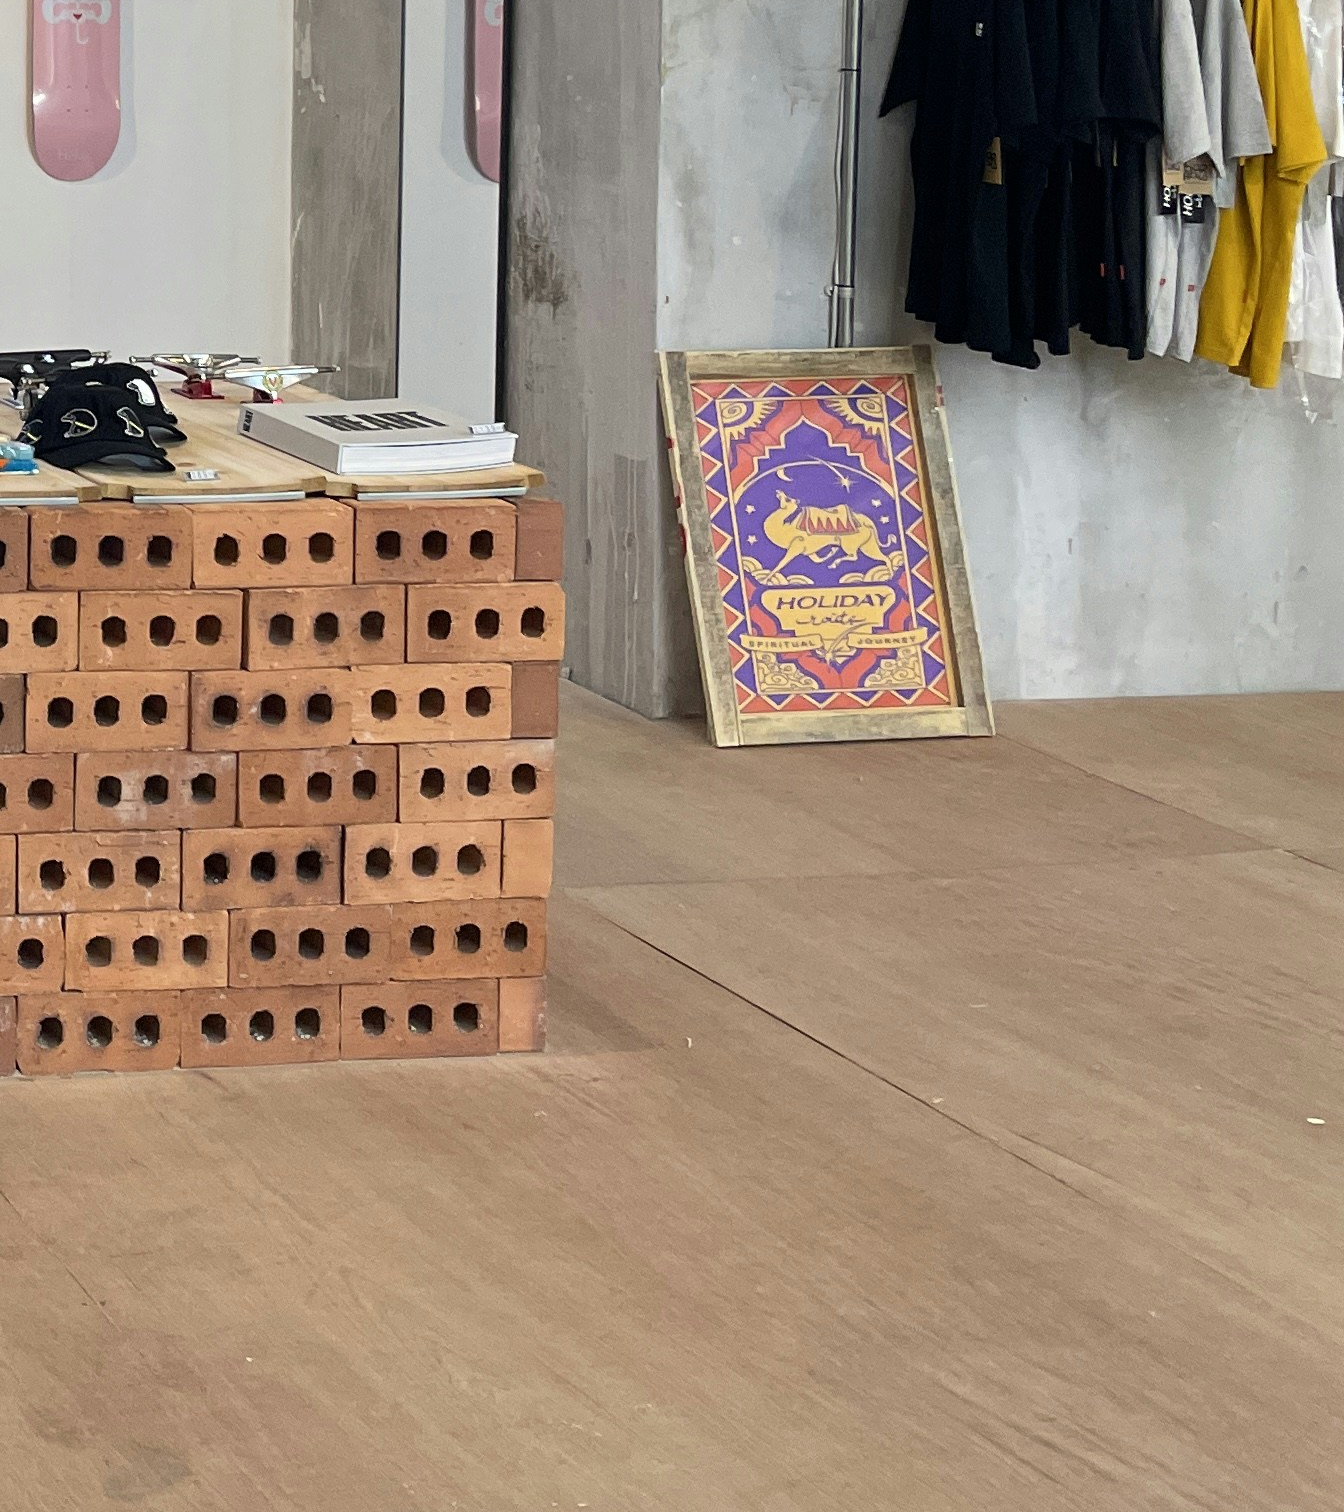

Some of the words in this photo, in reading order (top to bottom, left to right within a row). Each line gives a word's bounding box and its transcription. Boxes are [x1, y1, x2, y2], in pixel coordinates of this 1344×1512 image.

[305, 411, 449, 432] HEART
[776, 592, 894, 610] HOLIDAY
[748, 639, 816, 649] SPIRITUAL
[857, 635, 917, 645] JOURNEY
